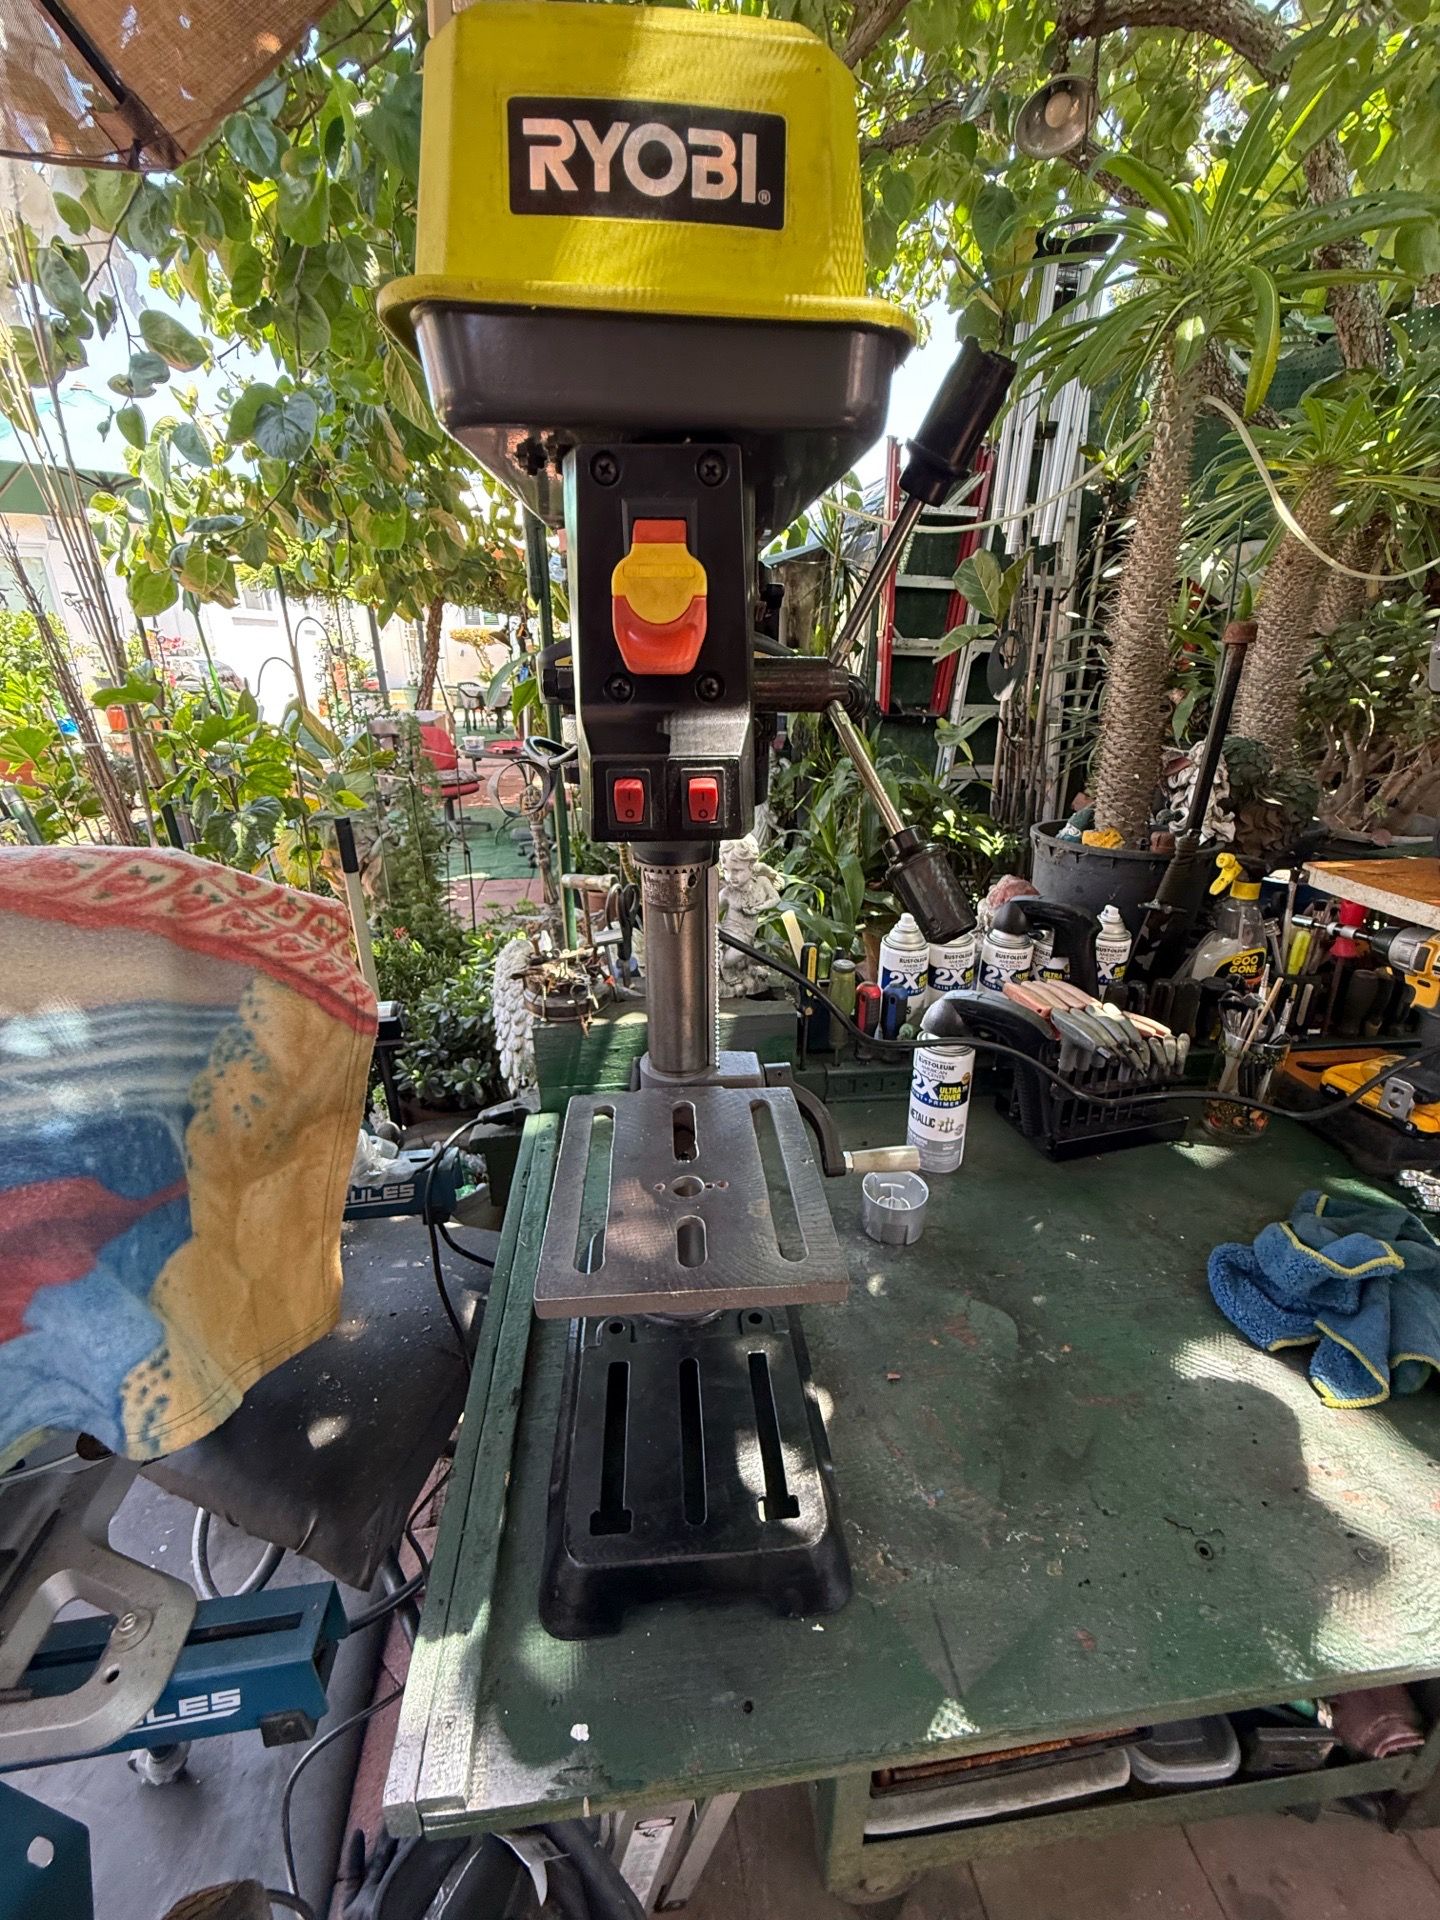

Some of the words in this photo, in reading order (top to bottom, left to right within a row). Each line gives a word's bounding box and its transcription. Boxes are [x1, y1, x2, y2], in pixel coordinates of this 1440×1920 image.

[522, 117, 758, 205] RYOBI
[1232, 955, 1259, 966] GOO
[934, 967, 966, 987] 2X
[984, 965, 1017, 985] 2X
[1229, 965, 1258, 974] GONE
[918, 1056, 956, 1071] RUST-OLEUM
[912, 1069, 941, 1101] 2X
[939, 1086, 962, 1094] ULTRA
[938, 1092, 962, 1101] COVER
